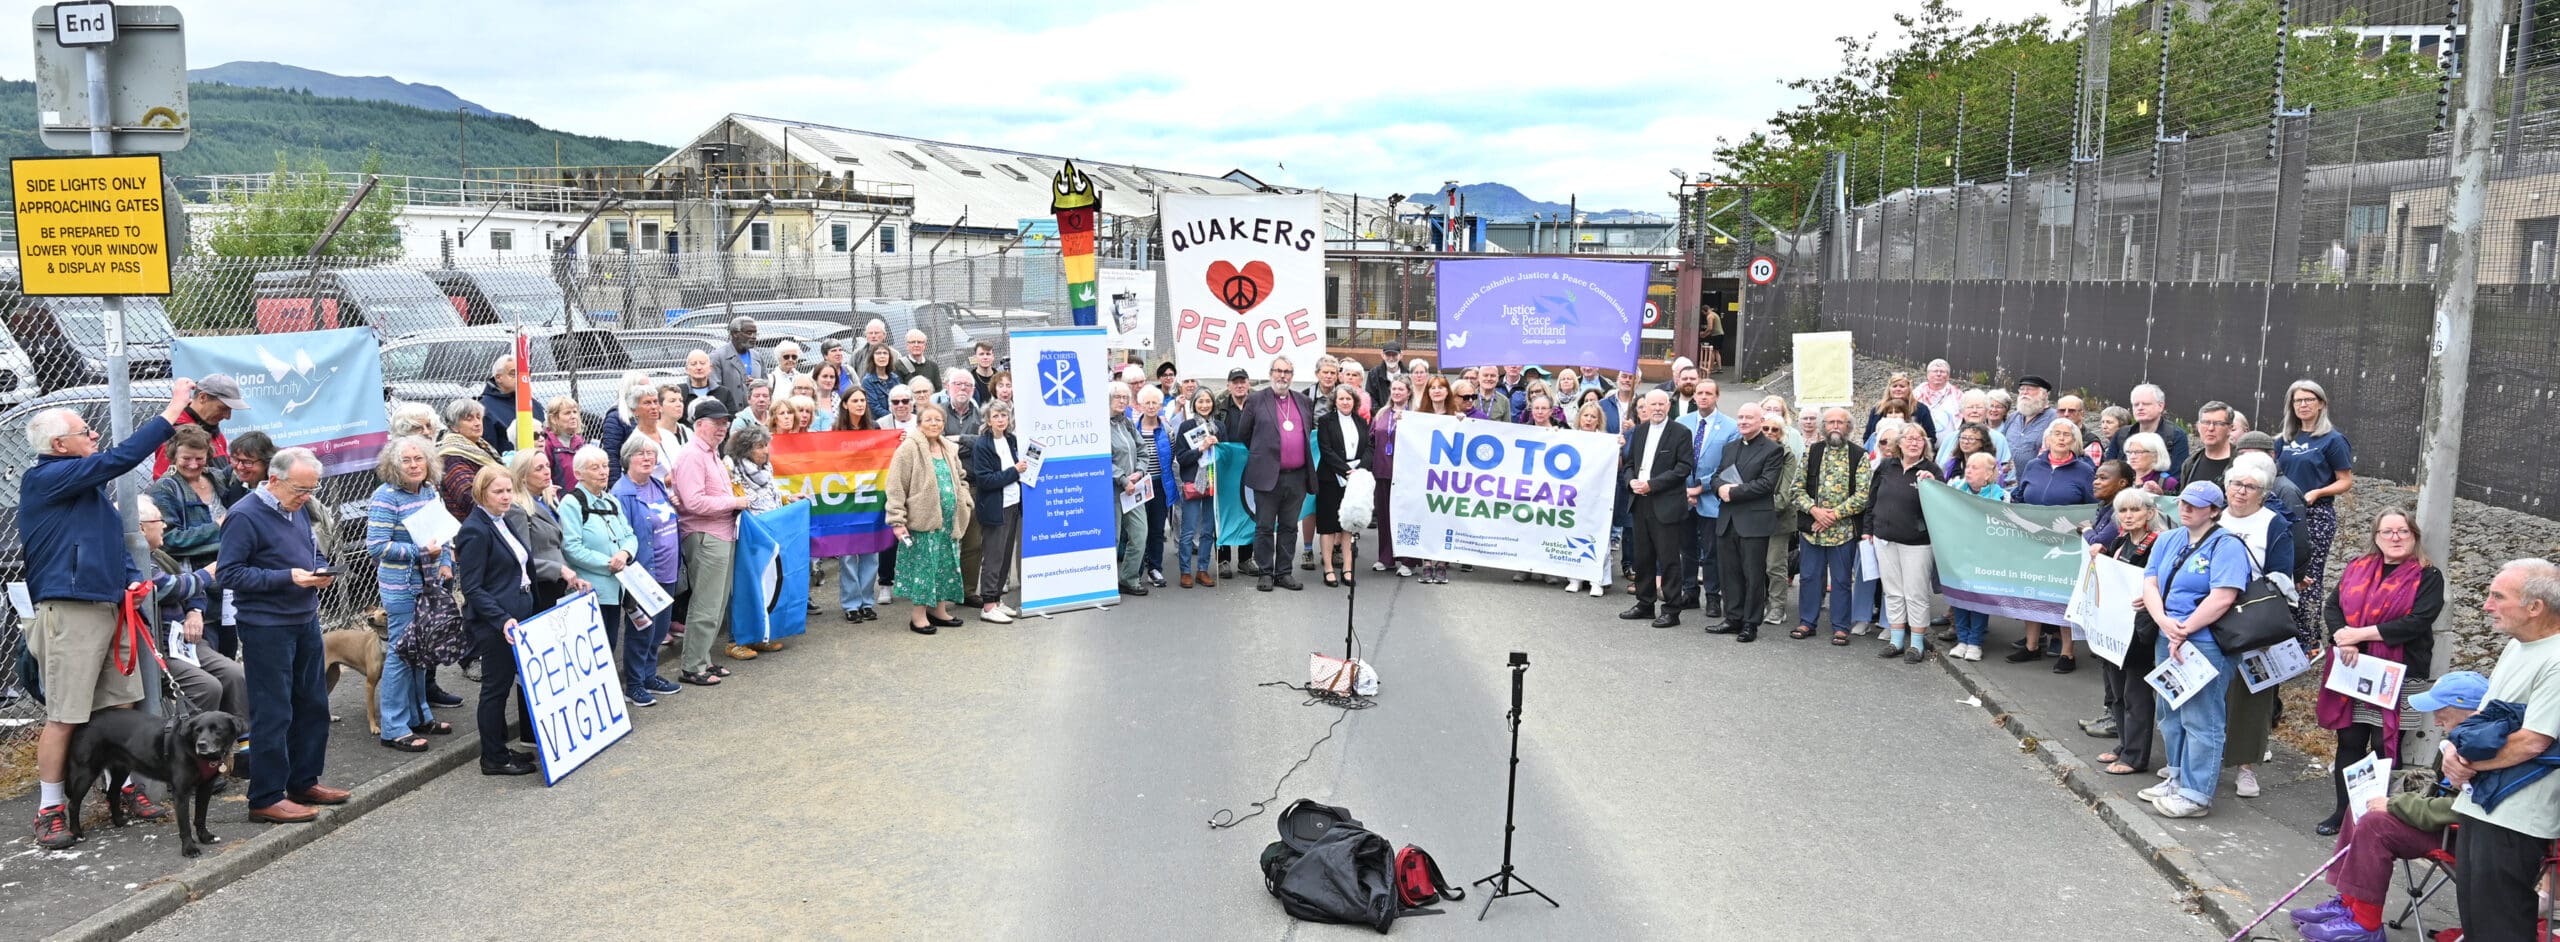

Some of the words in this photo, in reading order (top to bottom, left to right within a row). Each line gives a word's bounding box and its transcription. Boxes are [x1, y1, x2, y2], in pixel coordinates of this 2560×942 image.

[66, 13, 104, 32] End
[26, 179, 56, 192] SIDE
[60, 178, 107, 192] LIGHTS
[112, 177, 146, 190] ONLY
[19, 200, 111, 214] APPROACHING
[116, 199, 160, 212] GATES
[41, 227, 55, 238] BE
[60, 226, 119, 238] PREPARED
[124, 226, 140, 237] TO
[1172, 217, 1315, 252] QUAKERS
[26, 245, 66, 256] LOWER
[71, 244, 102, 256] YOUR
[107, 244, 158, 255] WINDOW
[48, 263, 55, 274] &
[59, 262, 106, 273] DISPLAY
[111, 262, 141, 273] PASS
[1754, 265, 1769, 276] 10
[1453, 292, 1480, 320] Scottish
[1480, 275, 1515, 294] Catholic
[1517, 272, 1550, 280] Justice
[1562, 273, 1588, 287] Peace
[1589, 282, 1629, 324] Commission
[1501, 304, 1536, 318] Justice
[1646, 308, 1654, 318] 0
[1511, 314, 1519, 325] &
[1522, 314, 1550, 325] Peace
[1176, 308, 1317, 358] PEACE
[1522, 324, 1566, 336] Scotland
[1035, 422, 1053, 430] Pax
[1058, 420, 1093, 429] Christi
[1036, 433, 1098, 447] COTLAND
[1429, 429, 1504, 470] NO
[1515, 439, 1581, 480] TO
[773, 474, 878, 506] EACE
[1065, 485, 1083, 494] family
[1426, 468, 1578, 508] NUCLEAR
[1065, 496, 1084, 504] school
[1066, 507, 1084, 517] parish
[1426, 493, 1575, 529] WEAPONS
[1050, 531, 1067, 539] wider
[1068, 528, 1101, 538] community
[1541, 540, 1567, 549] Justice
[1549, 553, 1581, 563] Scotland
[1027, 564, 1112, 579] www.paxchristiscotland.org
[1975, 566, 2006, 576] Rooted
[2008, 569, 2017, 578] in
[2020, 571, 2046, 581] Hope:
[2048, 574, 2068, 584] lived
[526, 624, 608, 706] PEACE
[540, 683, 623, 762] VIGIL
